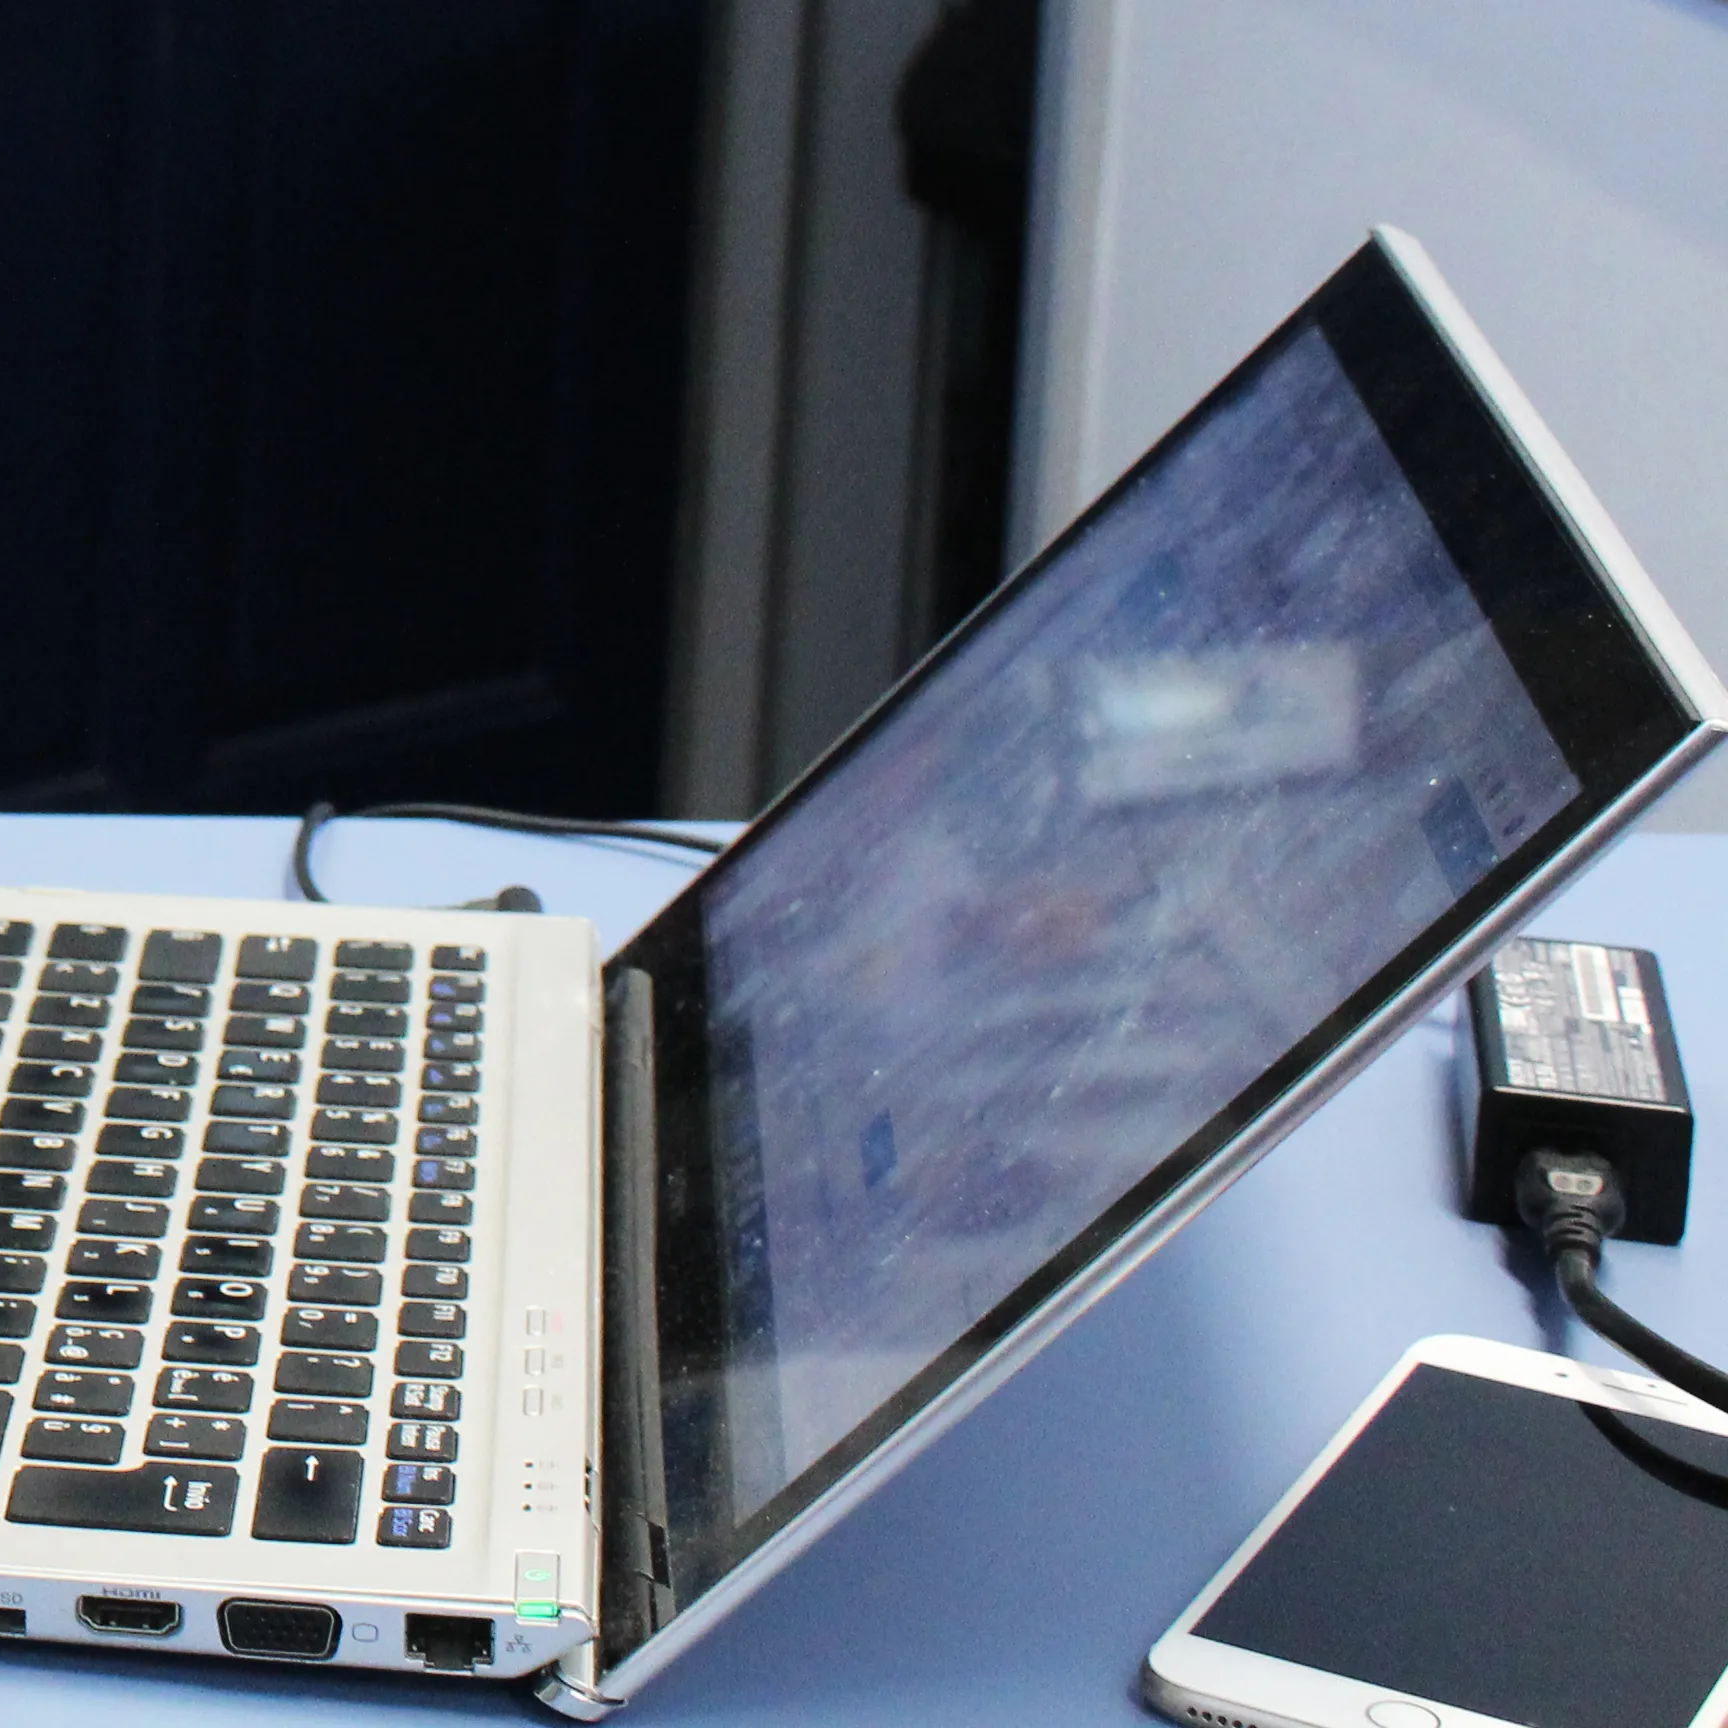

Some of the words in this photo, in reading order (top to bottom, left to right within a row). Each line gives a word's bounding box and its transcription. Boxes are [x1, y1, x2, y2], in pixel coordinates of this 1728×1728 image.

[164, 1020, 198, 1030] S
[156, 1055, 188, 1067] D
[51, 1065, 83, 1077] C
[151, 1090, 180, 1100] F
[43, 1102, 72, 1113] V
[141, 1127, 173, 1139] G
[248, 1125, 279, 1136] T
[32, 1137, 62, 1148] B
[133, 1164, 164, 1176] H
[241, 1162, 272, 1173] Y
[21, 1175, 53, 1188] N
[126, 1203, 156, 1212] J
[234, 1200, 266, 1212] U
[10, 1215, 45, 1230] M
[114, 1243, 148, 1255] K
[106, 1285, 140, 1295] L
[219, 1282, 253, 1297] O
[214, 1327, 246, 1339] P
[183, 1481, 213, 1510] Invio
[419, 1510, 440, 1533] Canc
